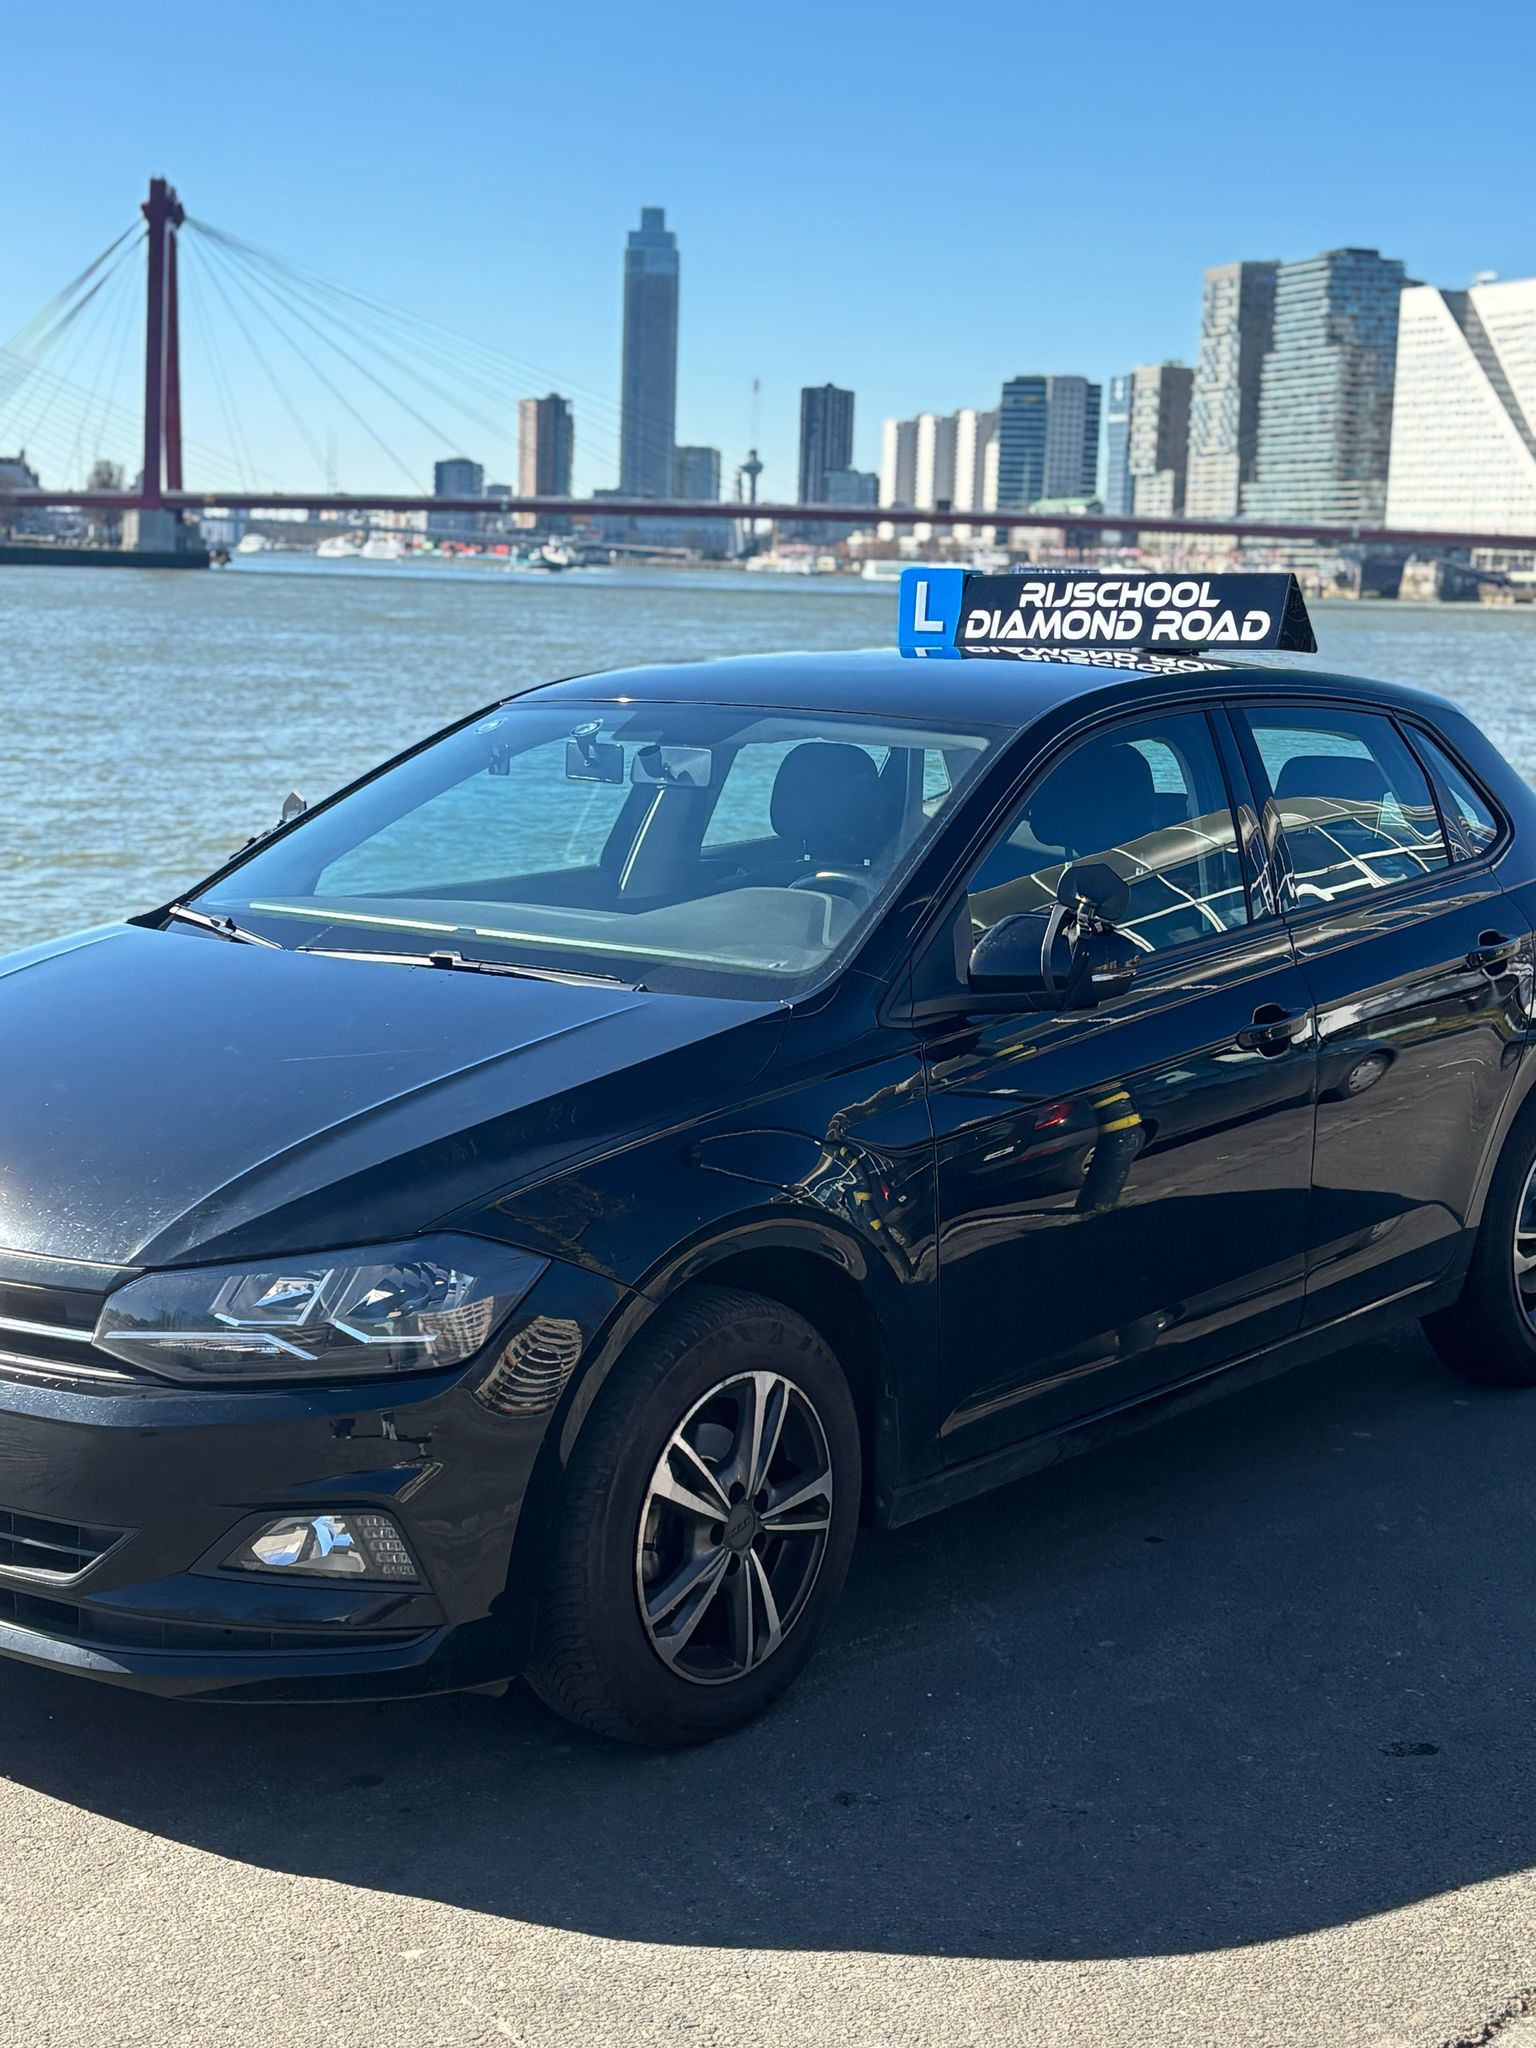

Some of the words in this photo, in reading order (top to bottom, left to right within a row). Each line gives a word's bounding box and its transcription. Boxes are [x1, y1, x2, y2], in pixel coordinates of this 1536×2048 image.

[914, 581, 944, 632] L
[1018, 581, 1221, 608] RIJSCHOOL
[964, 610, 1143, 640] DIAMOND
[1151, 610, 1272, 641] ROAD
